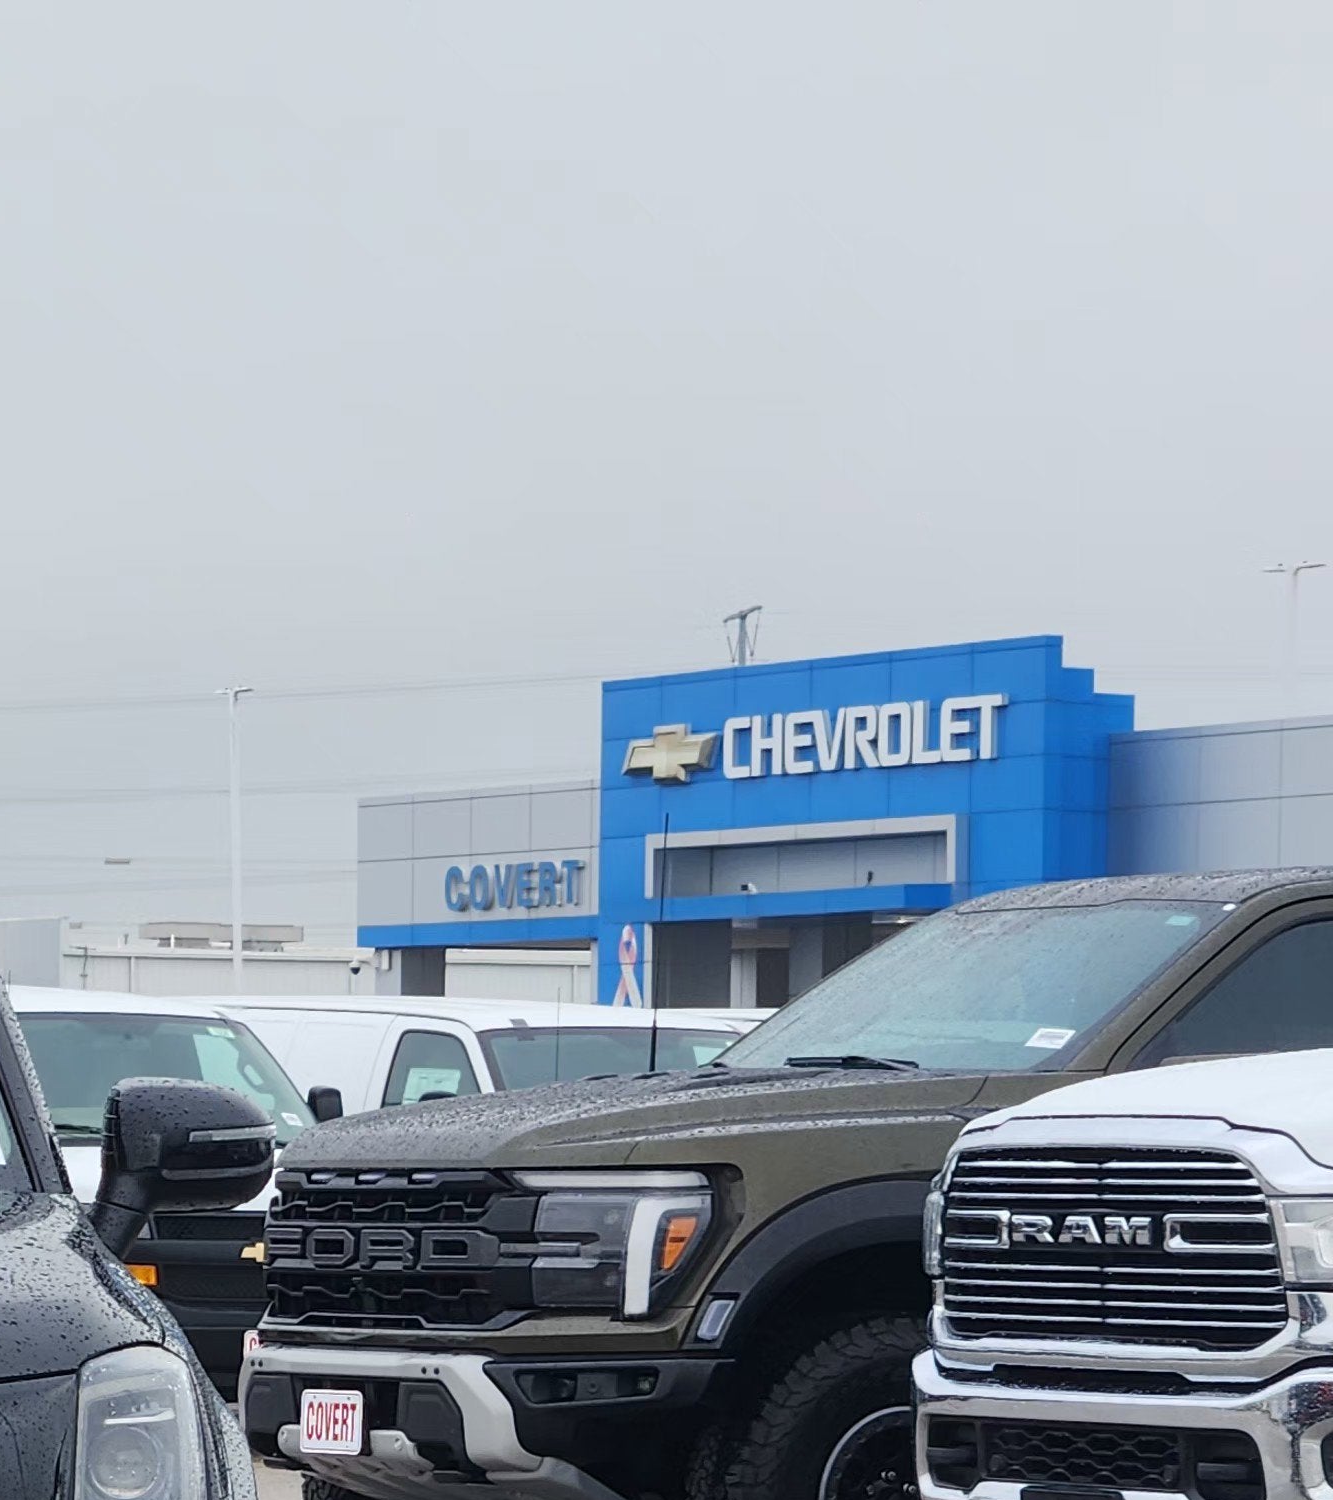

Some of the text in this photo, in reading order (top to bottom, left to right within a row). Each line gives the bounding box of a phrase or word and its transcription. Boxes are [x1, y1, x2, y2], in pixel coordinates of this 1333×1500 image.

[723, 693, 1009, 780] CHEVROLET
[445, 859, 586, 912] COVERT
[264, 1228, 500, 1270] FORD
[1011, 1213, 1152, 1246] RAM
[306, 1401, 357, 1442] COVERT
